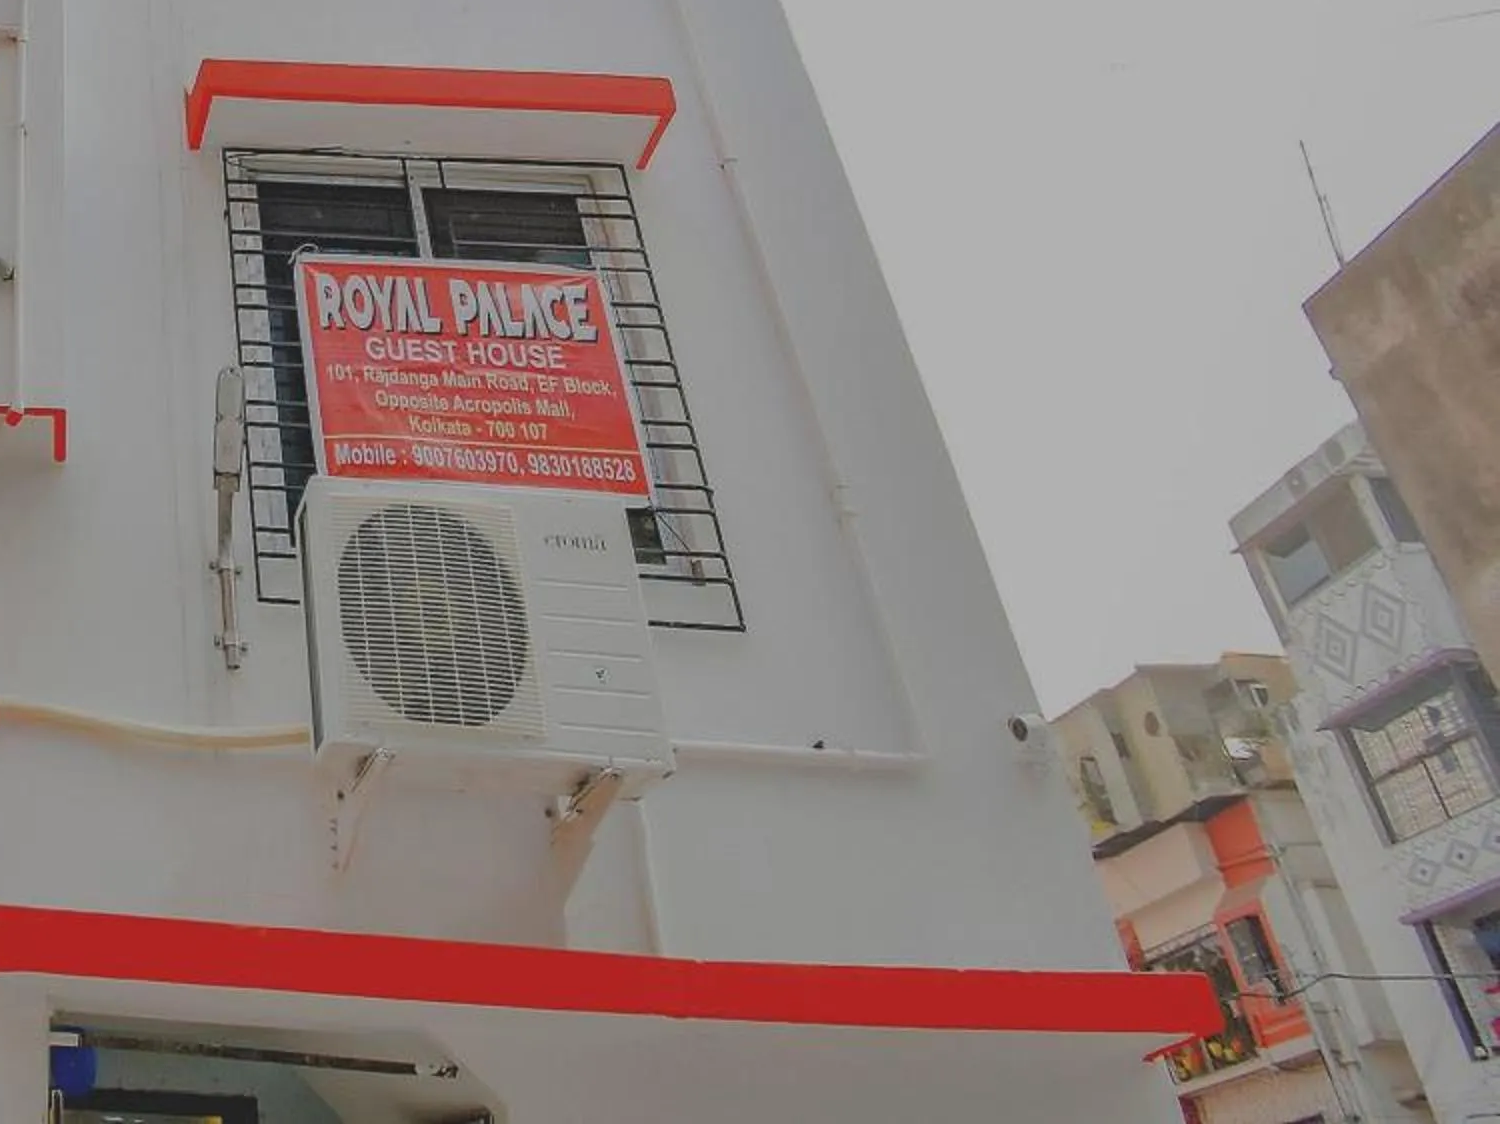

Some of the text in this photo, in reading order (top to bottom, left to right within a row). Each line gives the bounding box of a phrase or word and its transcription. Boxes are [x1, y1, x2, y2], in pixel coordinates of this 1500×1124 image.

[314, 272, 598, 342] ROYAL PALACE
[365, 337, 566, 369] GUEST HOUSE
[327, 364, 359, 383] 101,
[363, 365, 438, 390] Rajdanga
[442, 370, 481, 388] Main
[485, 373, 534, 394] Road,
[537, 375, 559, 393] EF
[375, 389, 575, 421] Opposite Acropolis Mall,
[408, 415, 472, 436] Kolkata
[485, 421, 516, 440] 700
[520, 423, 548, 440] 107
[334, 443, 396, 466] Mobile
[527, 453, 636, 482] 9830188528
